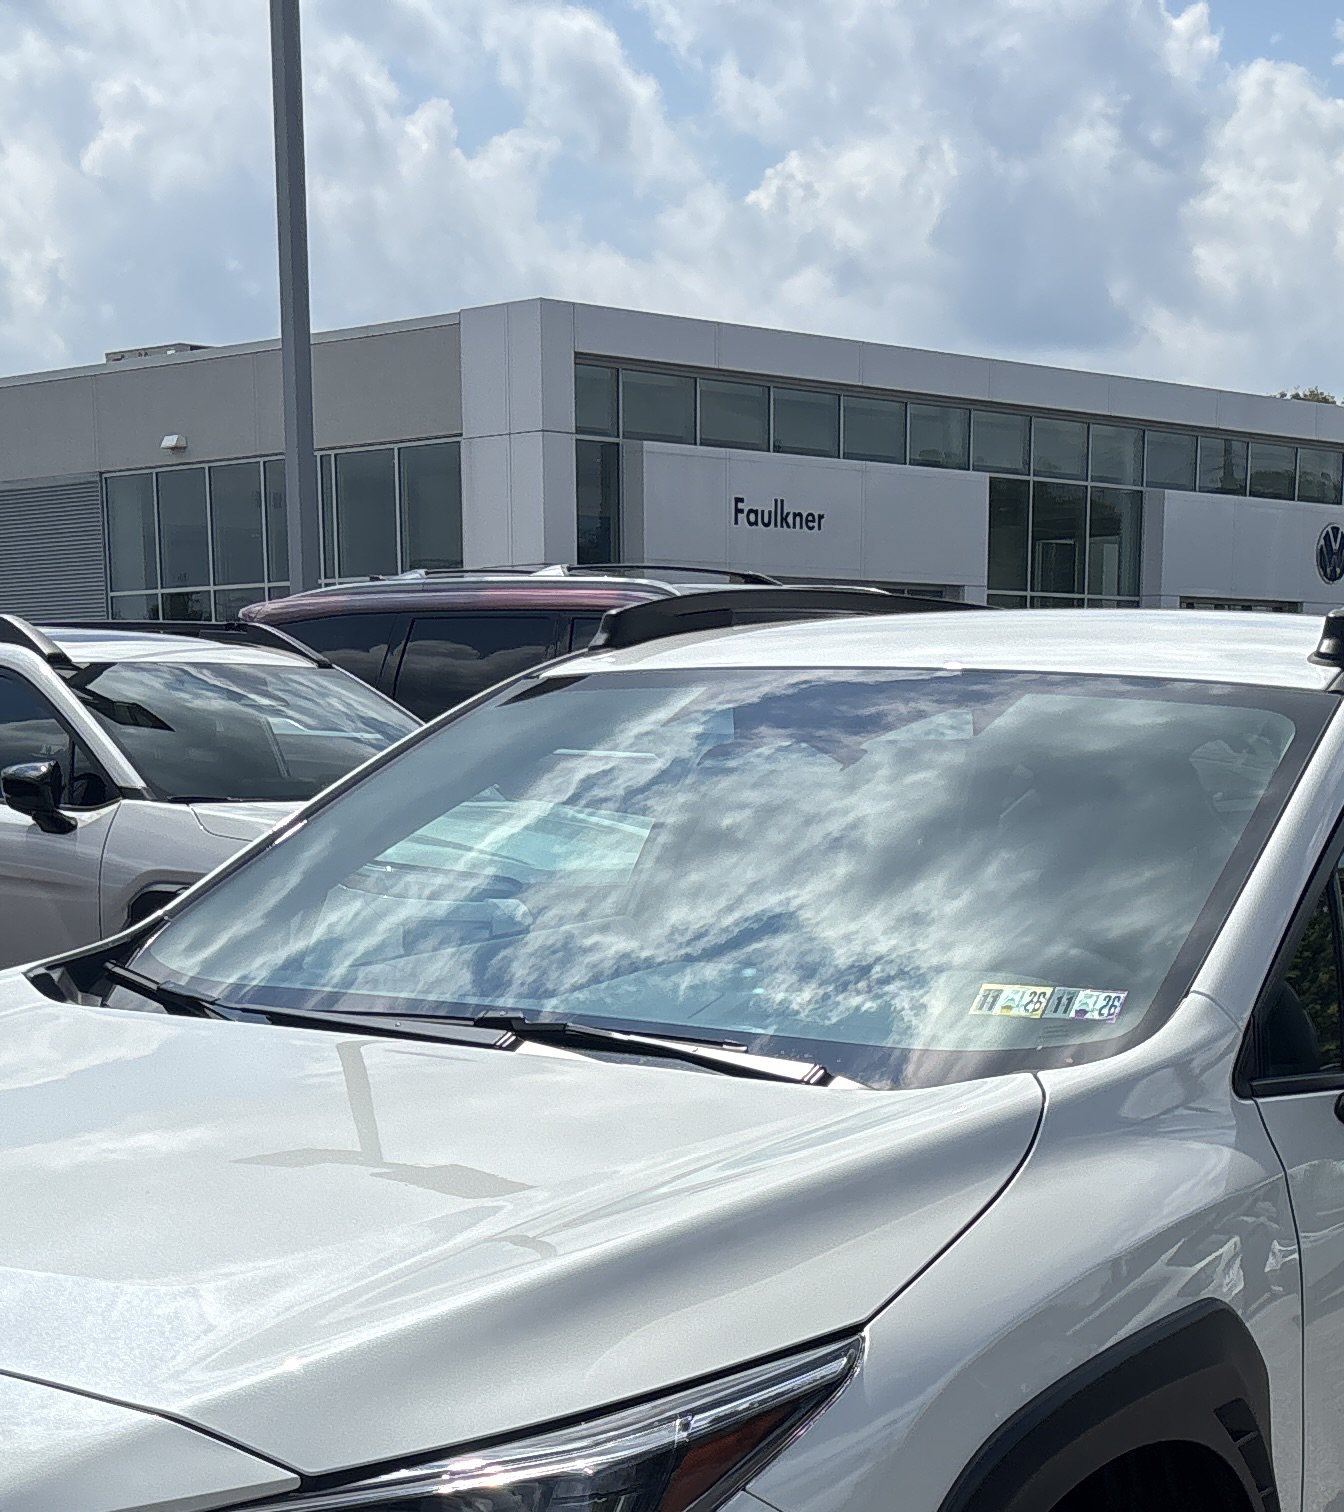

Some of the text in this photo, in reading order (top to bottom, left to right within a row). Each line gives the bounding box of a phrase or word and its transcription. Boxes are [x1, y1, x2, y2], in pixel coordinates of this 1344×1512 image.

[733, 496, 825, 531] Faulkner
[977, 990, 1047, 1015] 11 26
[1052, 994, 1122, 1017] 11 26
